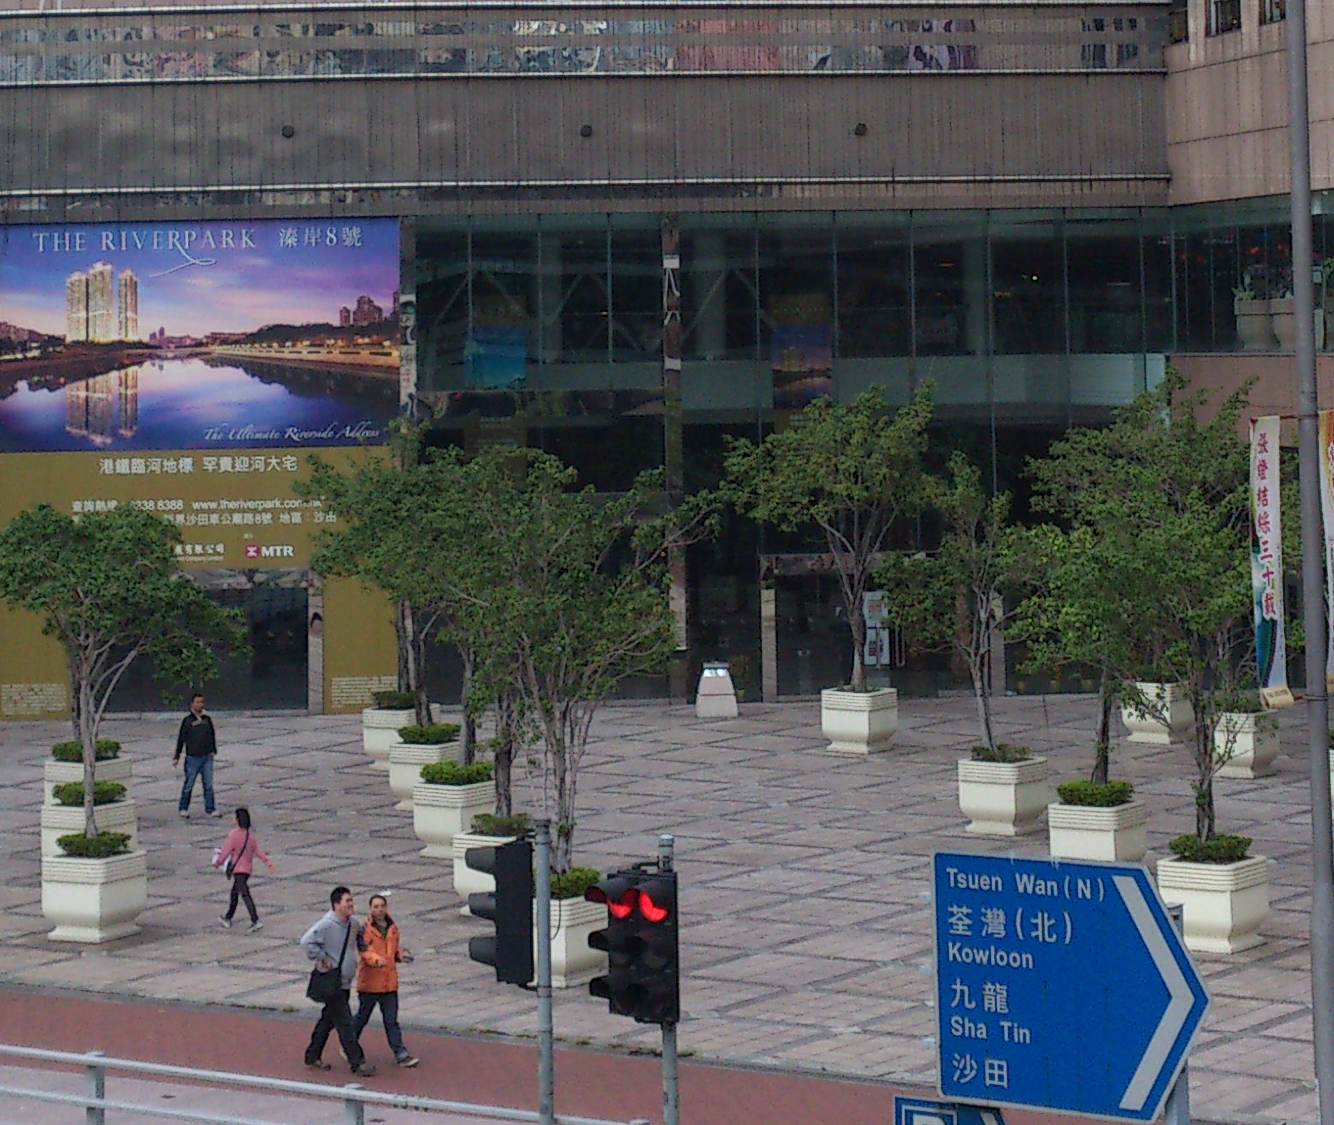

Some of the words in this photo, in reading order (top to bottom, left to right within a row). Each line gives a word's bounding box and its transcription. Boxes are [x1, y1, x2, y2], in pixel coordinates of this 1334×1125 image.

[32, 232, 87, 252] THE
[101, 228, 257, 263] RIVERPARK
[278, 226, 363, 248] 溱岸8號
[204, 422, 227, 440] The
[228, 424, 280, 441] Ultimate
[284, 422, 338, 442] Riverside
[202, 455, 298, 473] 罕貴迎河大宅
[157, 499, 184, 510] 8388
[260, 544, 295, 557] MTR
[946, 867, 1003, 892] Tsuen
[947, 941, 1034, 970] Kowloon
[950, 978, 1010, 1014] 九龍
[950, 1015, 988, 1040] Sha
[1000, 1020, 1031, 1044] Tin
[951, 1052, 1009, 1089] 沙田
